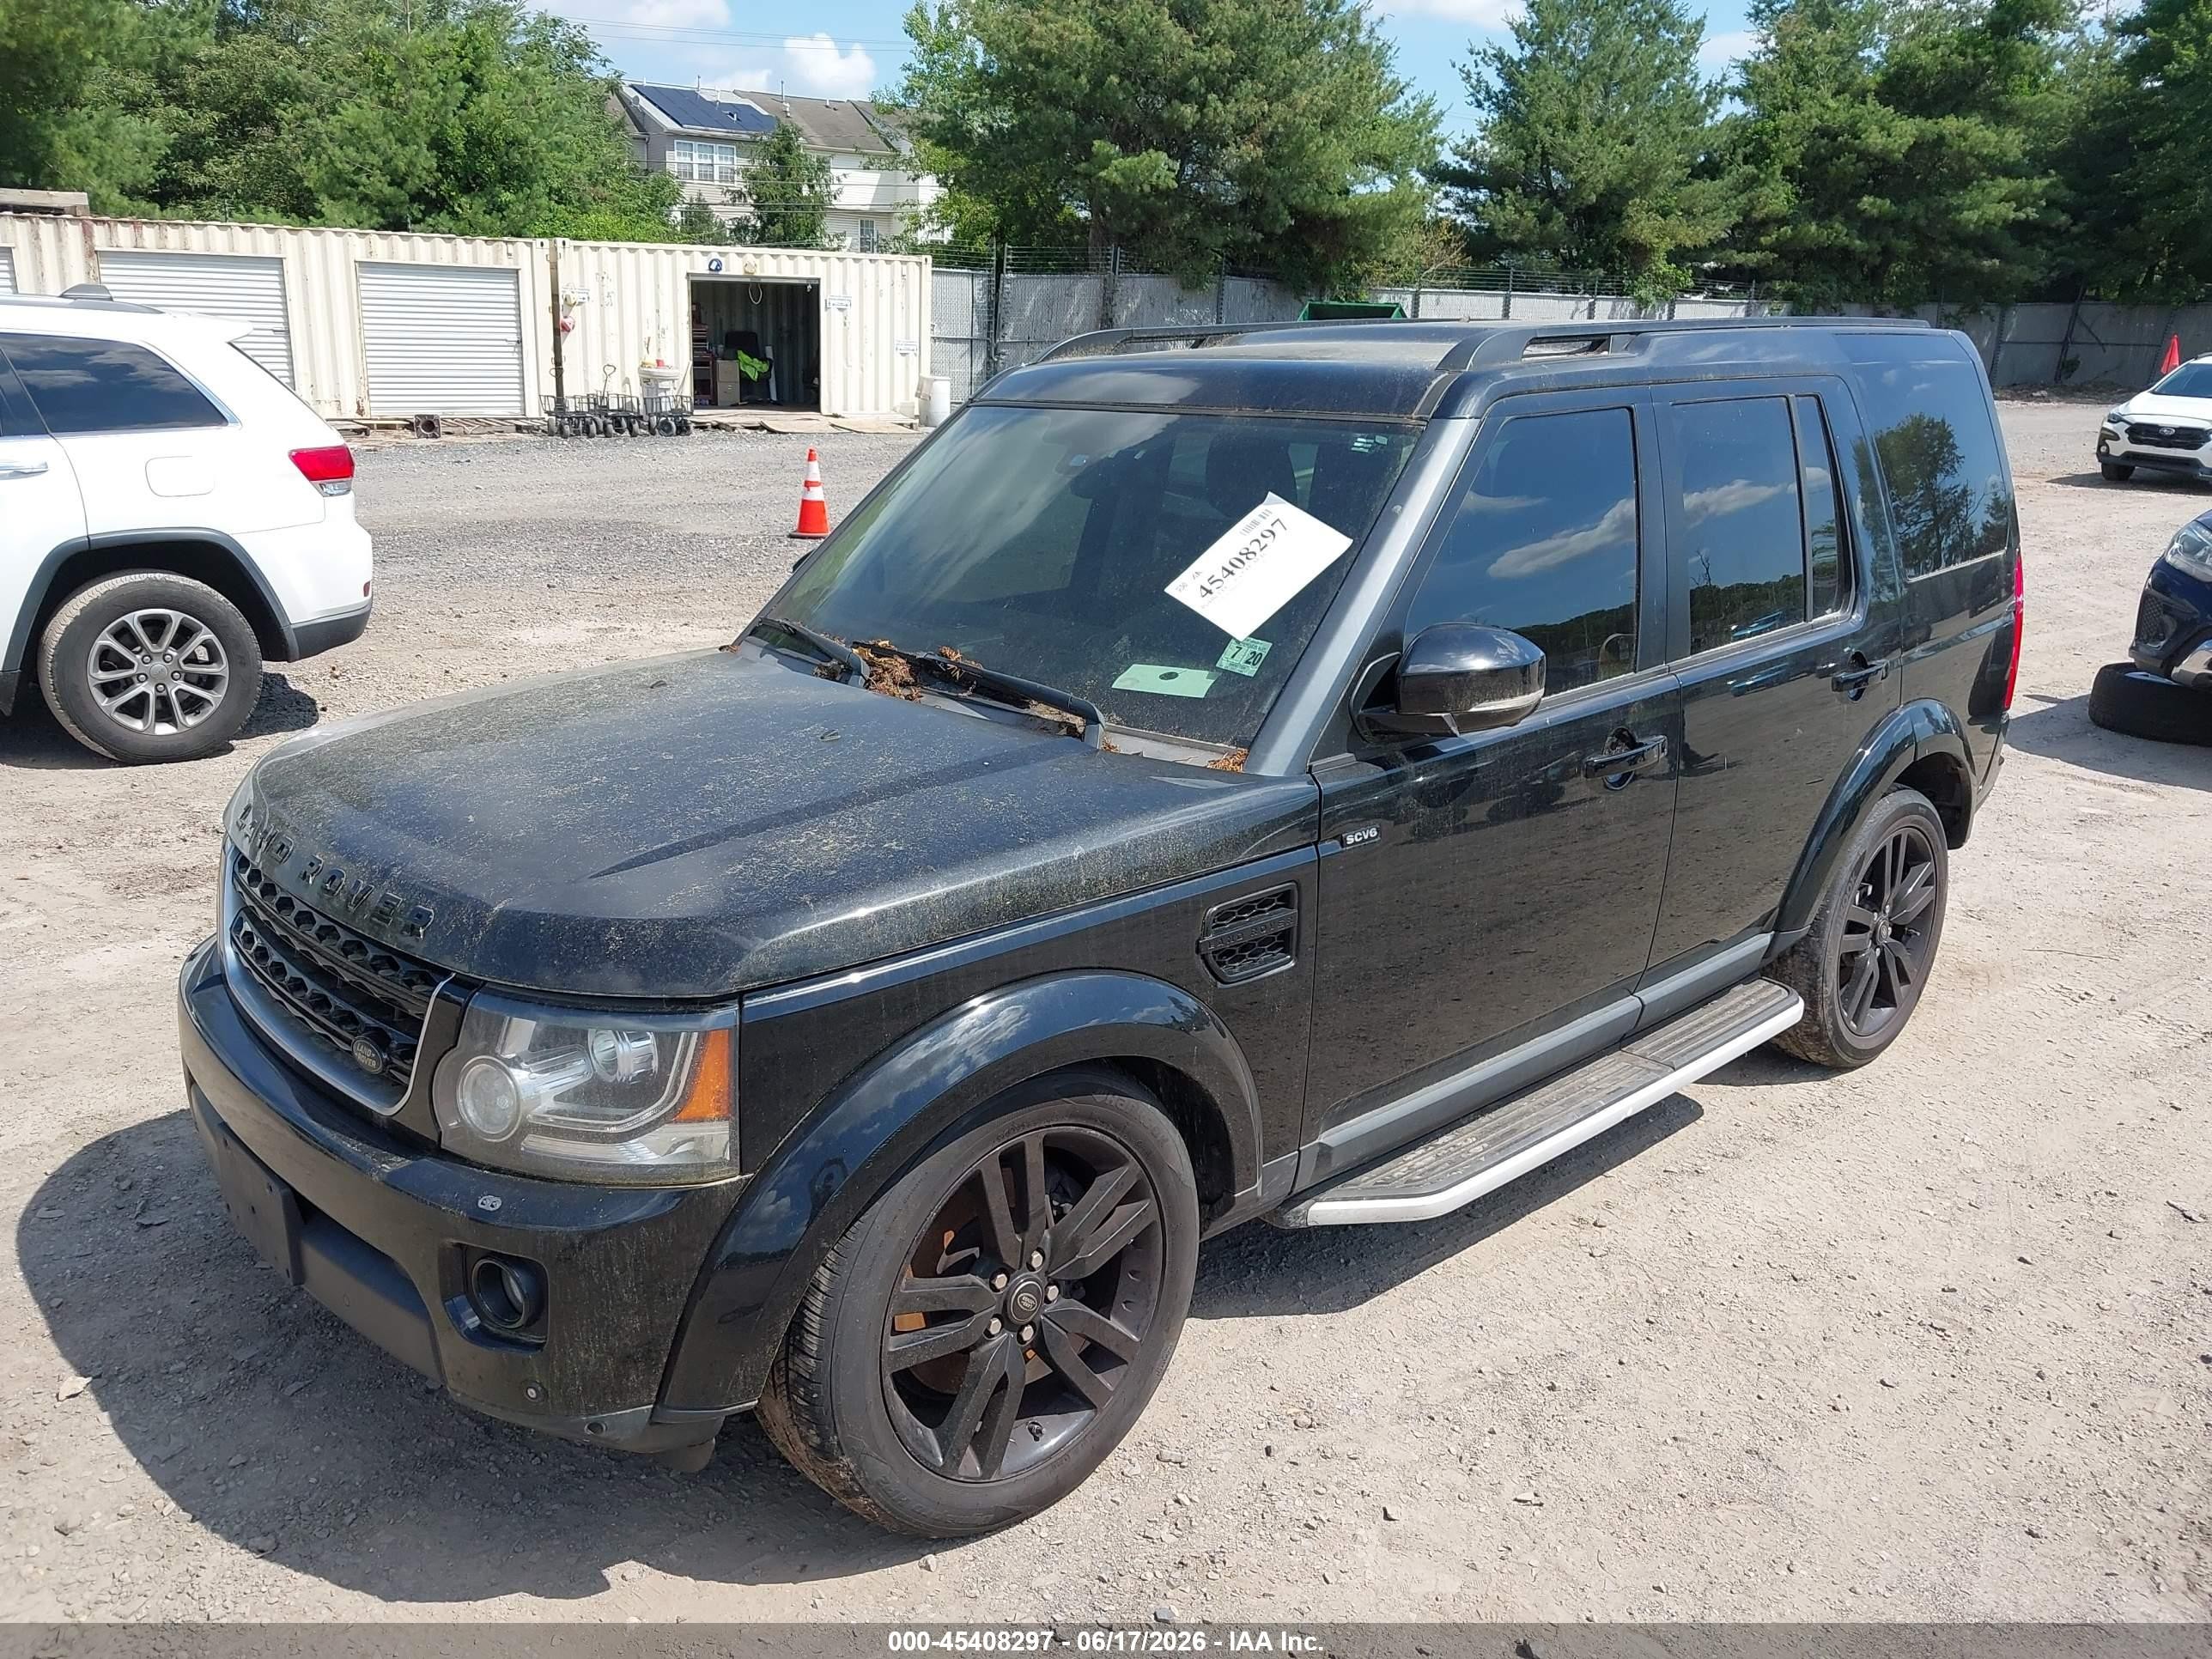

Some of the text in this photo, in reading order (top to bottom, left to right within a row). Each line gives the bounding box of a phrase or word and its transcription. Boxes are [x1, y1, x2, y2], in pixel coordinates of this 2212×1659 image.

[1200, 518, 1288, 599] 45408297
[1231, 646, 1263, 666] 7 20
[1346, 828, 1377, 845] SCV6
[301, 854, 434, 941] ROVER
